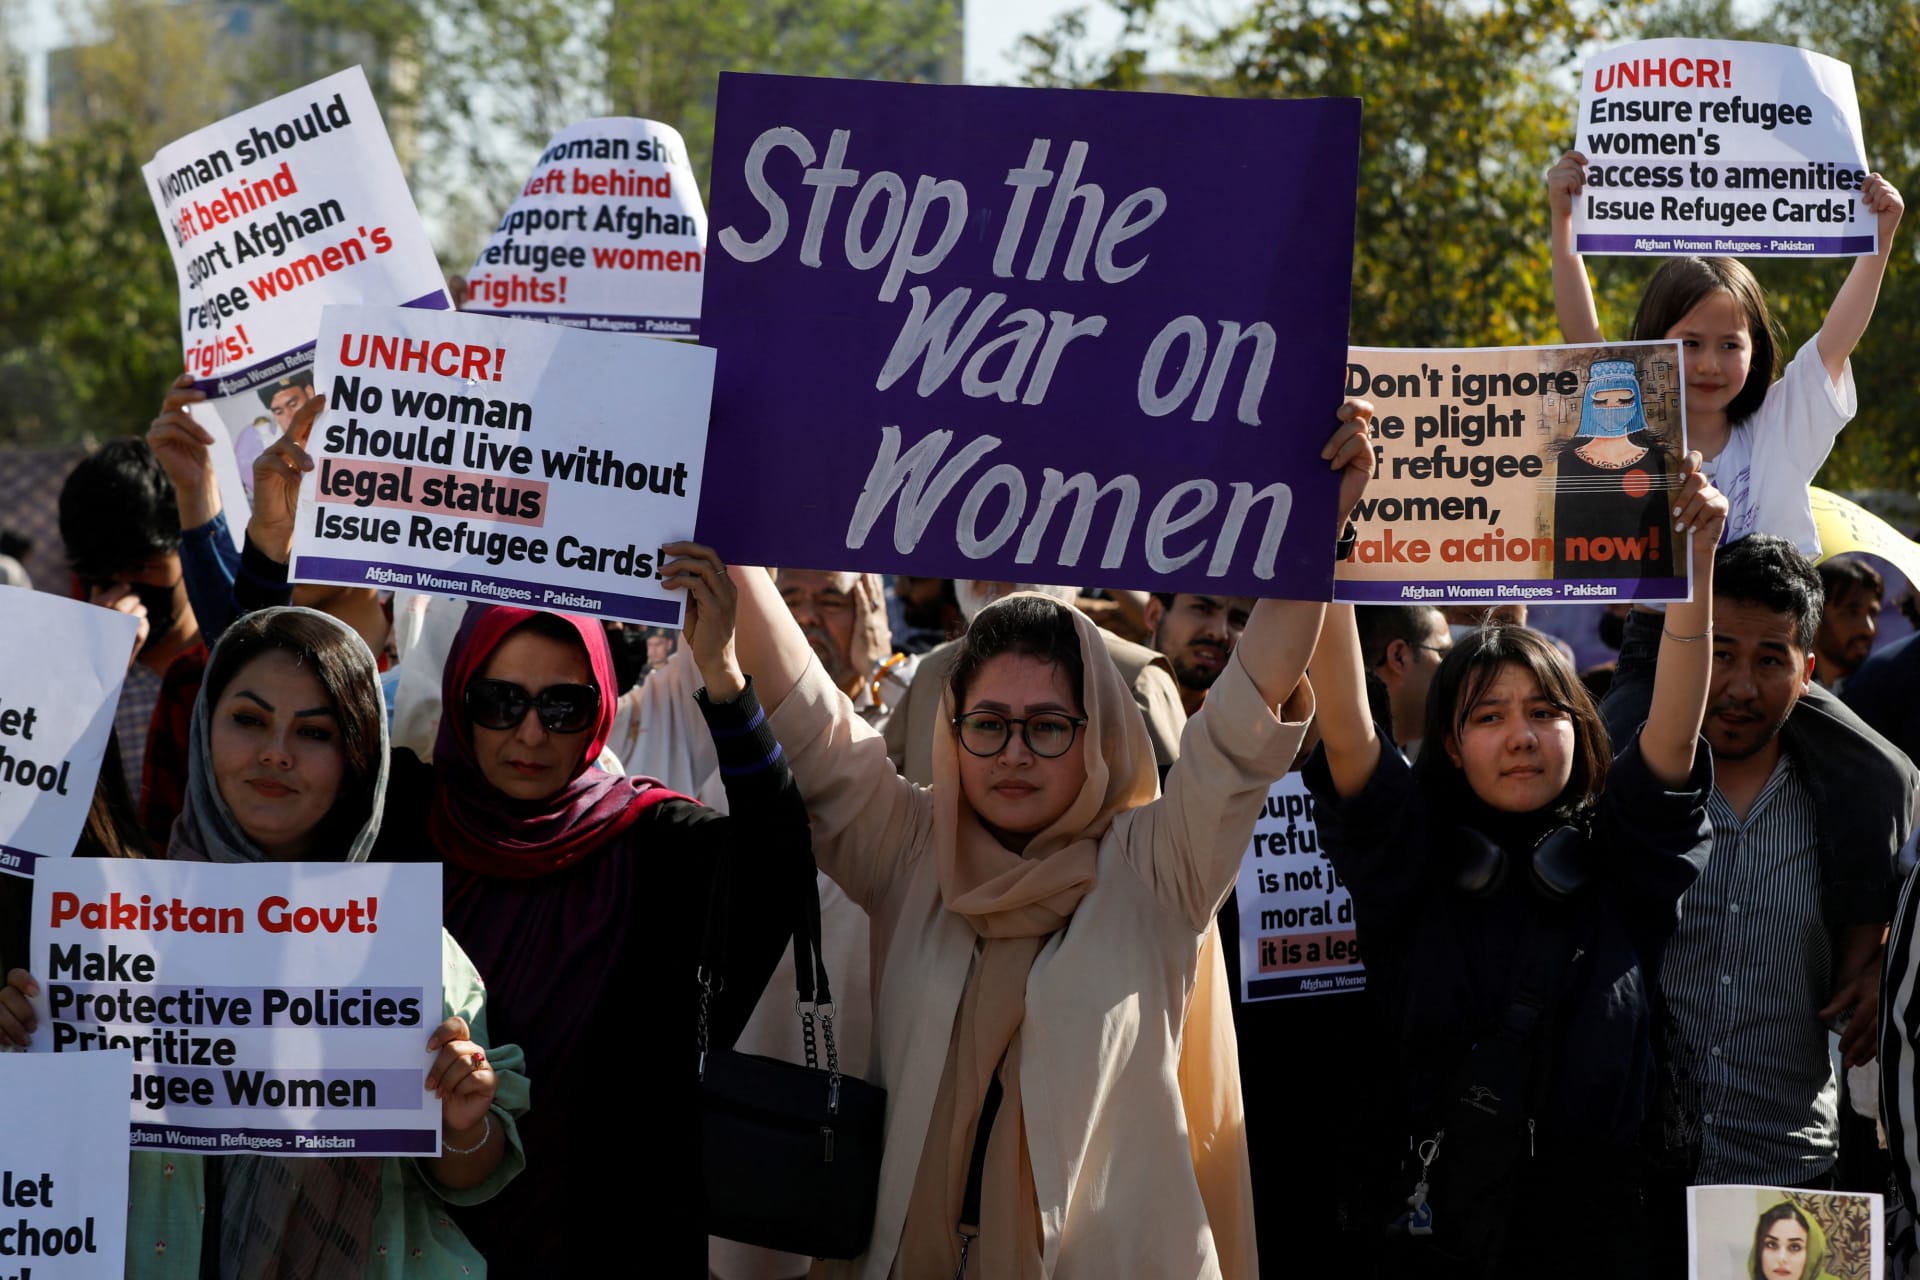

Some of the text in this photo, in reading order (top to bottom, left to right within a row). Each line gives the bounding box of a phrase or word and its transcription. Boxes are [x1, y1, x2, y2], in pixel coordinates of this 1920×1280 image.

[1595, 58, 1732, 93] UNHCR!
[236, 93, 351, 166] should
[1589, 96, 1813, 131] Ensure refugee
[538, 138, 629, 167] woman
[1587, 128, 1720, 155] women's
[573, 168, 672, 198] behind
[1587, 161, 1867, 192] access to amenities
[193, 162, 298, 231] behind
[718, 126, 1168, 302] Stop the
[1587, 196, 1855, 227] Issue Refugee Cards!
[233, 199, 346, 265] Afghan
[593, 205, 696, 240] Afghan
[249, 225, 393, 302] women's
[1634, 239, 1670, 252] Afghan
[1673, 239, 1712, 250] Women
[1714, 239, 1762, 252] Refugees
[1770, 240, 1815, 251] Pakistan
[467, 274, 567, 308] rights!
[590, 317, 637, 331] Refugees
[645, 320, 691, 333] Pakistan
[339, 333, 506, 382] UNHCR!
[1137, 314, 1277, 426] on
[1345, 363, 1578, 405] Don't ignore
[330, 375, 533, 432] No woman
[1415, 404, 1526, 447] plight
[323, 419, 688, 497] should live without
[1392, 445, 1543, 487] refugee
[319, 460, 541, 519] legal status
[846, 425, 1293, 580] Women
[1351, 495, 1501, 526] women,
[314, 507, 666, 580] Issue Refugee Cards!
[1440, 527, 1555, 563] action
[1565, 527, 1660, 562] now!
[365, 567, 413, 586] Afghan
[416, 573, 468, 592] Women
[471, 579, 532, 601] Refugees
[543, 589, 602, 610] Pakistan
[1401, 585, 1444, 599] Afghan
[1447, 585, 1494, 597] Women
[1497, 584, 1553, 599] Refugees
[1564, 584, 1617, 596] Pakistan
[0, 705, 37, 741] et
[1257, 869, 1279, 894] is
[1284, 866, 1323, 891] not
[50, 892, 378, 934] Pakistan Govt!
[1261, 900, 1333, 930] moral
[49, 944, 155, 983] Make
[1262, 942, 1277, 967] it
[1282, 939, 1302, 965] is
[1306, 944, 1320, 963] a
[1300, 978, 1333, 992] Afghan
[49, 985, 420, 1027] Protective Policies
[52, 1022, 237, 1066] Prioritize
[222, 1070, 377, 1108] Women
[166, 1131, 217, 1147] Women
[220, 1133, 283, 1149] Refugees
[295, 1135, 356, 1149] Pakistan
[3, 1171, 54, 1208] let
[0, 1217, 97, 1256] chool
